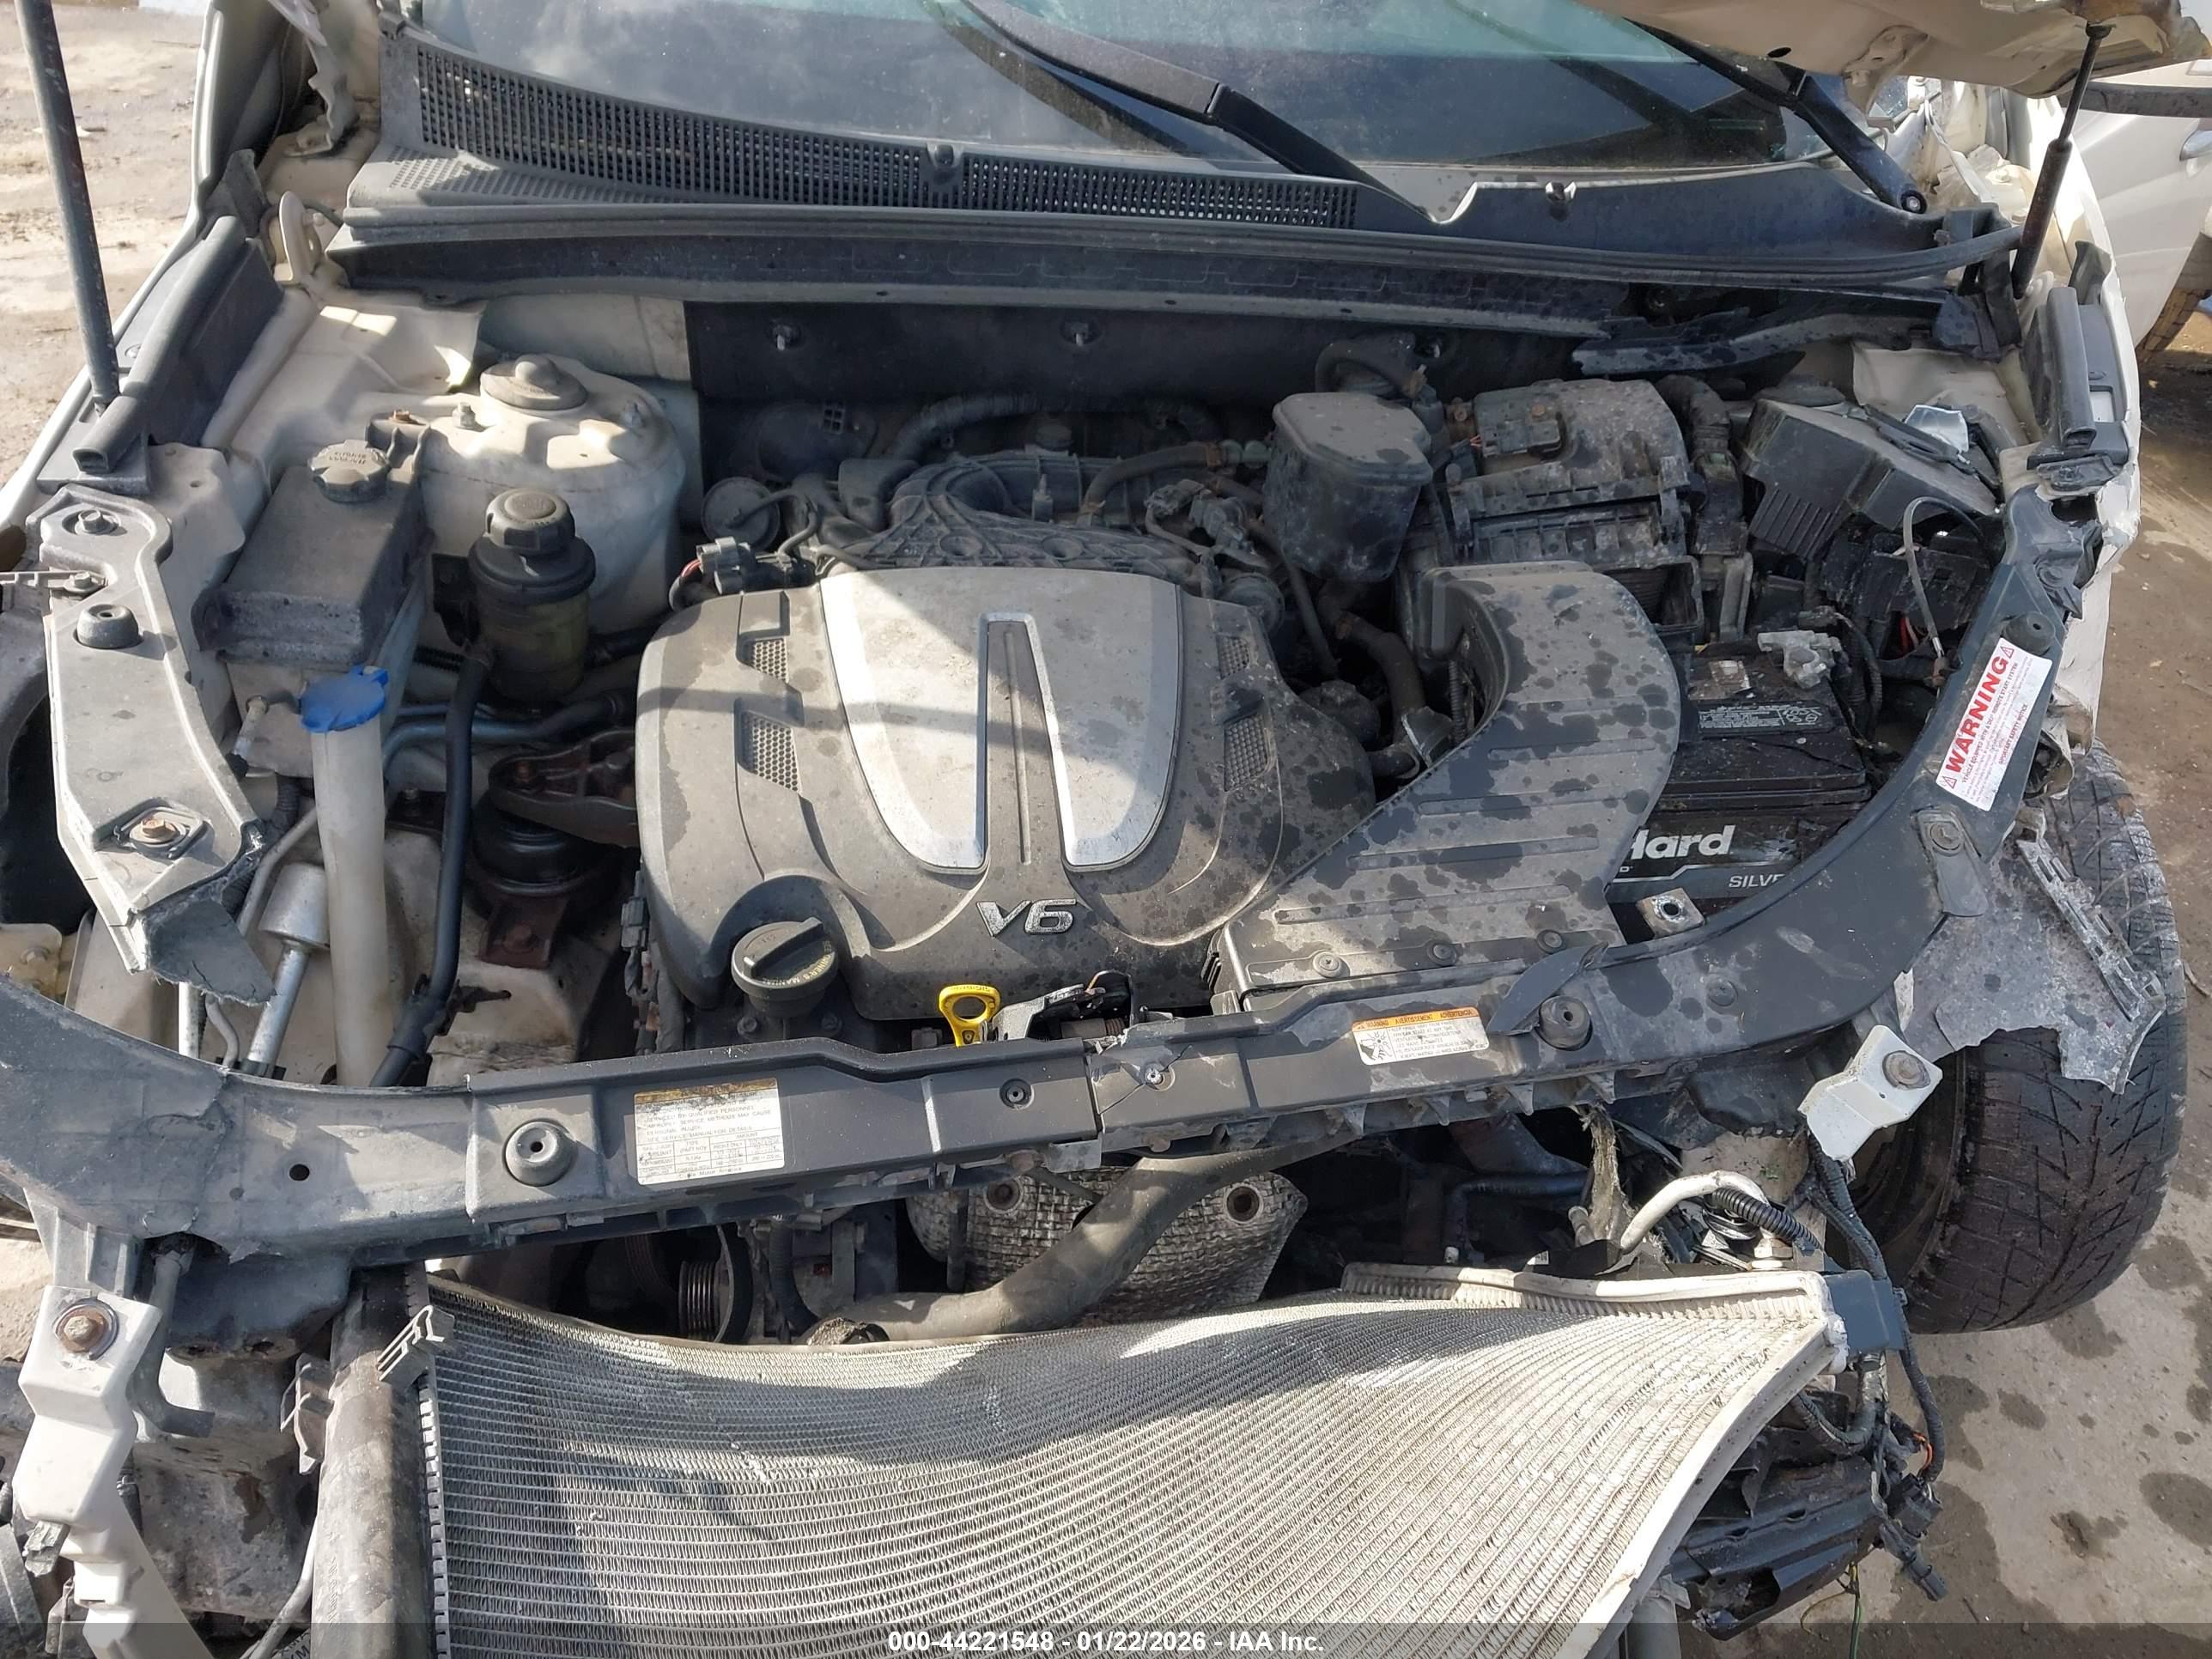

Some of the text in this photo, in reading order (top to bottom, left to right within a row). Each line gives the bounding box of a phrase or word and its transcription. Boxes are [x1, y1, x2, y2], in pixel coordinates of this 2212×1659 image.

[2001, 680, 2011, 695] START
[1946, 655, 2009, 773] WARNING
[2009, 720, 2021, 739] SAFETY
[2017, 703, 2028, 721] NOTICE
[976, 898, 1077, 937] V6
